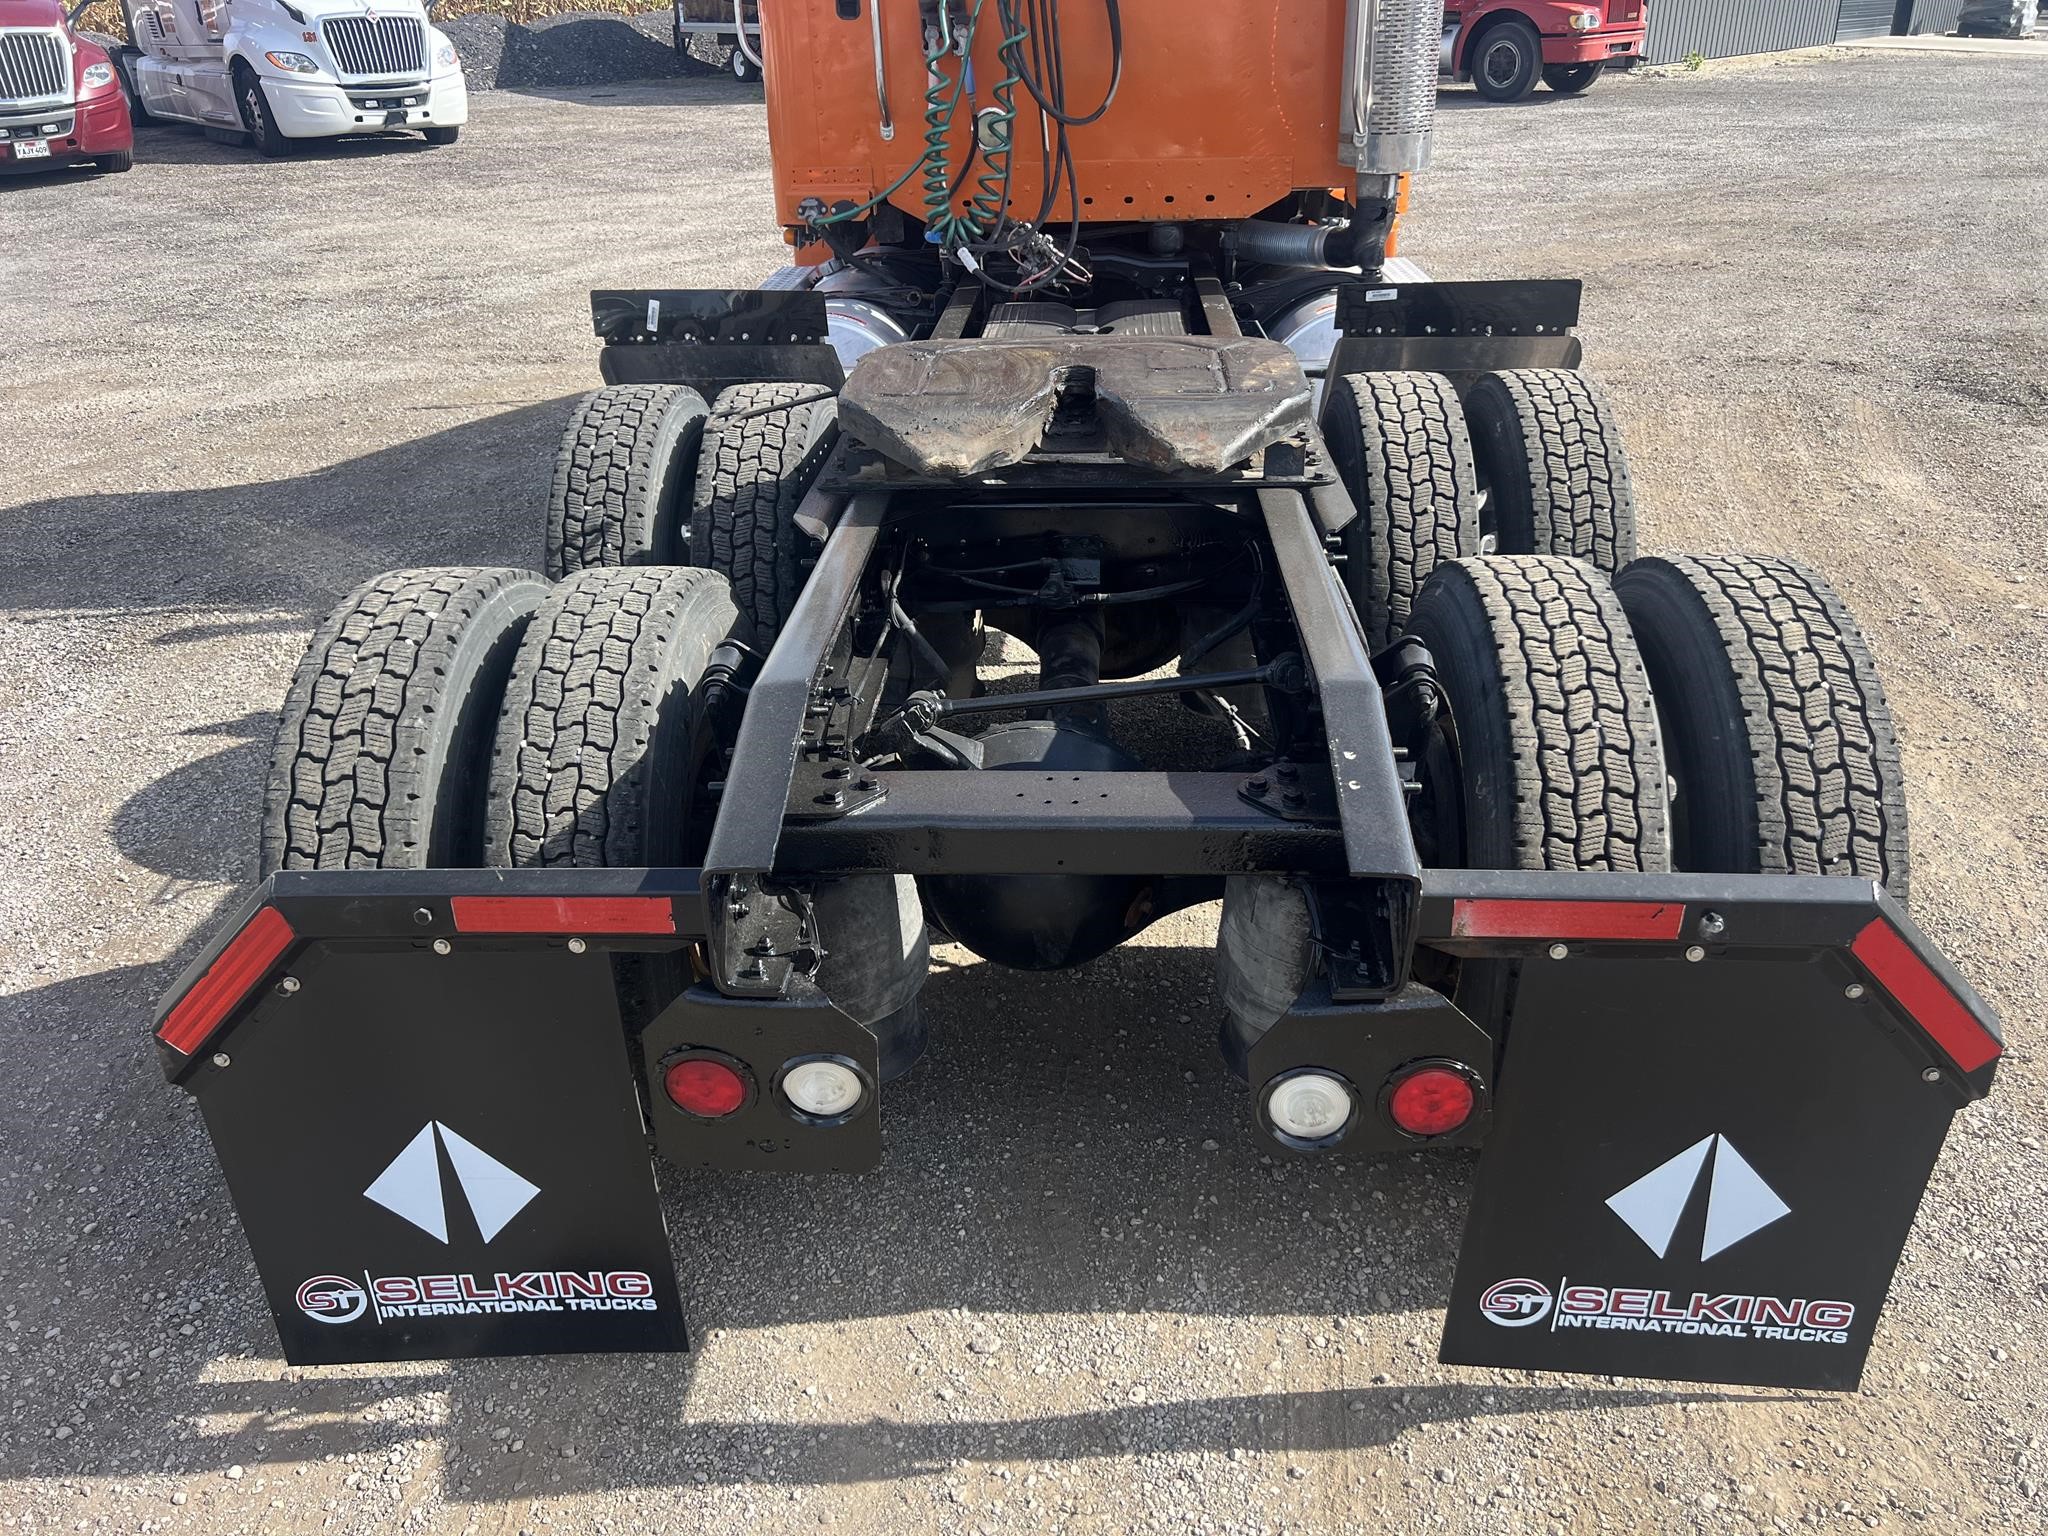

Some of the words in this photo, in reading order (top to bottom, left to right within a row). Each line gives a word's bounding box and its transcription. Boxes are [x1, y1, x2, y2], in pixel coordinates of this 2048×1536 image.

[373, 1271, 653, 1304] SELKING
[380, 1299, 563, 1318] INTERNATIONAL
[565, 1298, 658, 1311] TRUCKS
[1560, 1286, 1855, 1329] SELKING
[1557, 1314, 1747, 1337] INTERNATIONAL
[1752, 1326, 1848, 1344] TRUCKS
